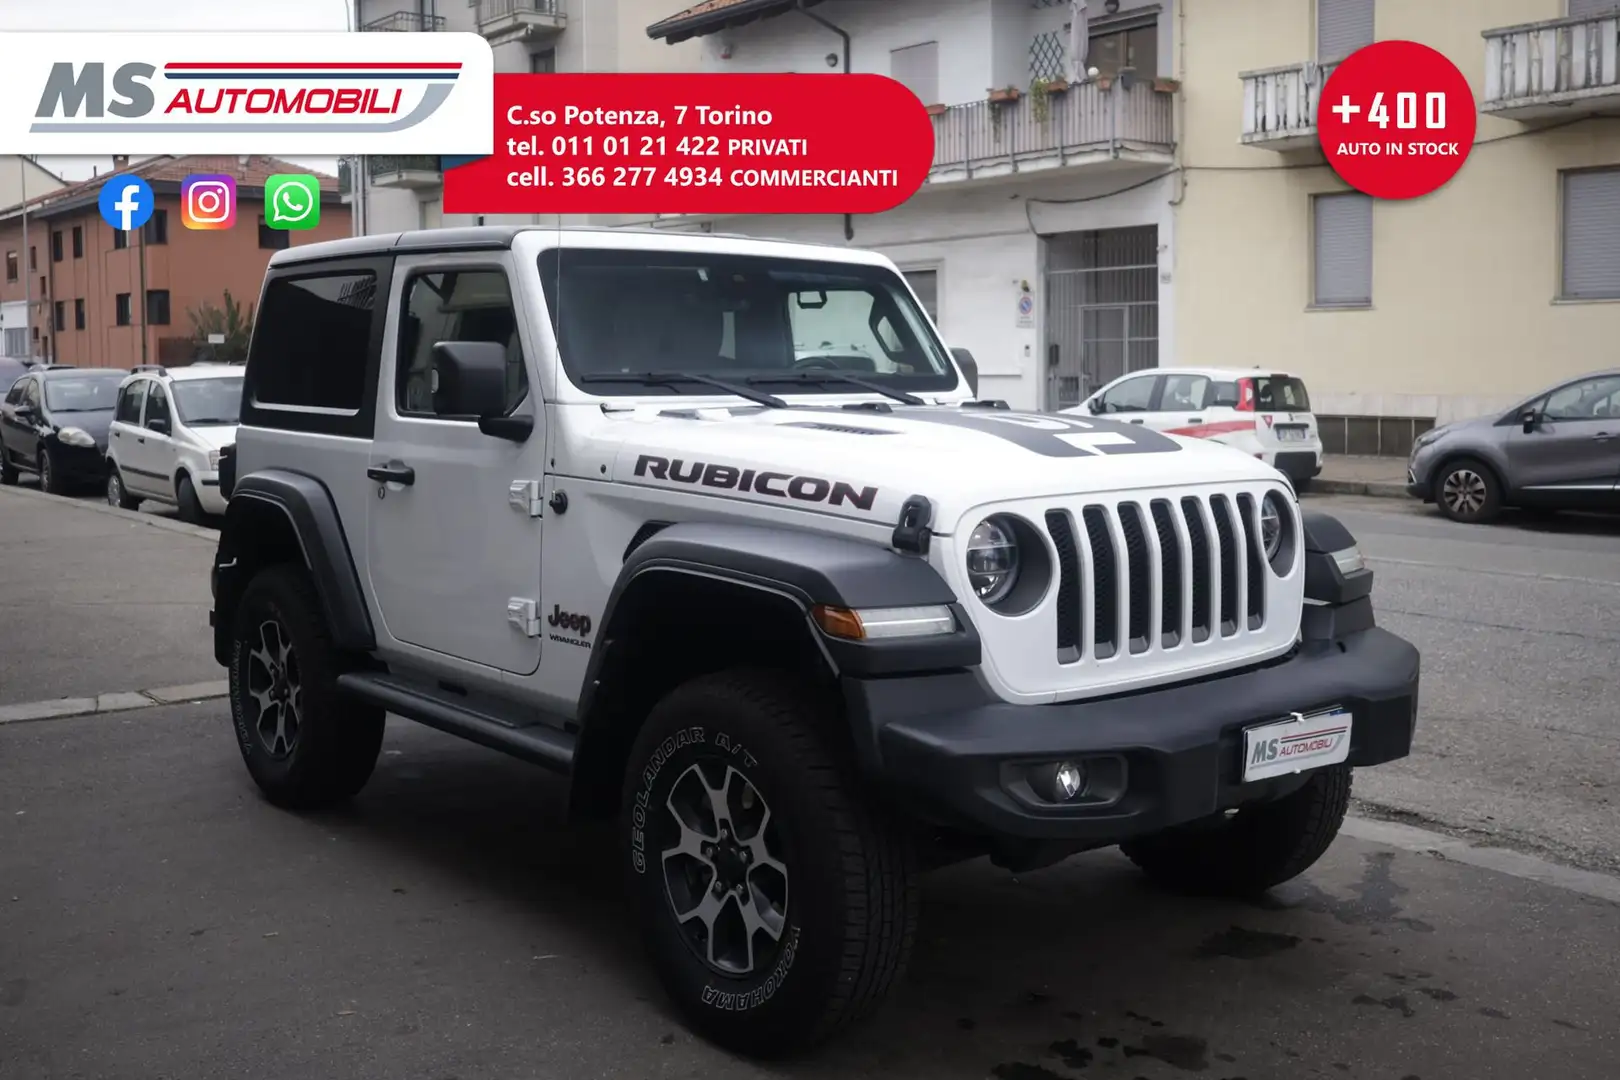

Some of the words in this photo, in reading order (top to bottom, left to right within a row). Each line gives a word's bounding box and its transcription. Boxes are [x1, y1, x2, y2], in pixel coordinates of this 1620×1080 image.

[633, 454, 879, 511] RUBICON
[548, 603, 592, 637] Jeep
[549, 632, 592, 649] WRANGLER
[1250, 738, 1279, 765] MS
[632, 726, 706, 874] GEOLANDAR
[714, 732, 759, 768] A/T
[701, 924, 802, 1011] YOKOHAMA
